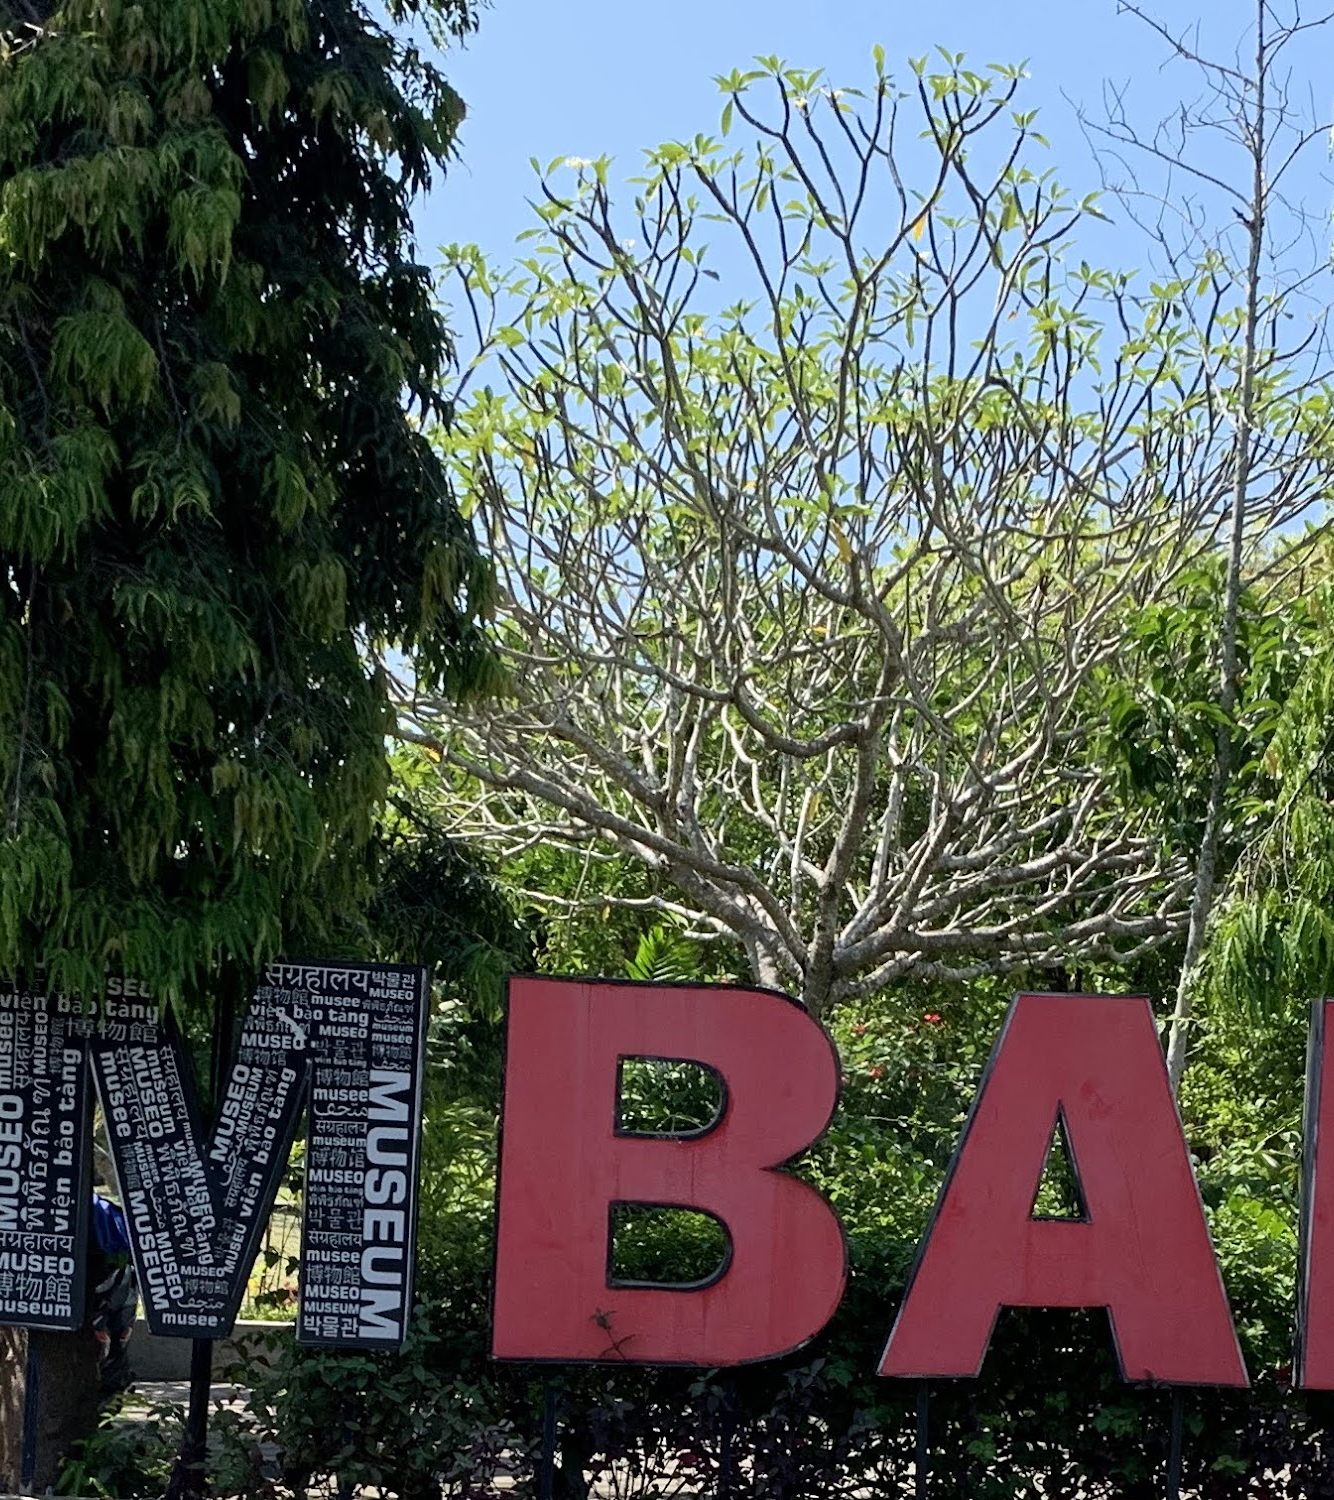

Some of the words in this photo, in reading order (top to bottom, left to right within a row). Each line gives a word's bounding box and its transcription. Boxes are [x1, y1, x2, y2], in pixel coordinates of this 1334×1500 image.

[369, 988, 414, 1000] MUSEO
[319, 1024, 368, 1039] MUSEO
[372, 1022, 414, 1033] museum
[33, 1011, 49, 1075] MUSEO
[241, 1032, 306, 1051] MUSEO
[99, 1051, 132, 1138] musee
[129, 1046, 165, 1139] MUSEO
[145, 1049, 177, 1134] museum
[235, 1067, 264, 1135] MUSEUM
[313, 1088, 369, 1102] musee
[209, 1064, 252, 1163] MUSEO
[312, 1136, 367, 1147] museum
[132, 1140, 155, 1190] MUSEO
[309, 1168, 365, 1184] MUSEO
[358, 1069, 412, 1340] MUSEUM
[128, 1190, 171, 1311] MUSEUM
[306, 1249, 361, 1263] musee
[155, 1231, 185, 1300] MUSEO
[180, 1265, 225, 1278] MUSEO
[305, 1284, 360, 1300] MUSEO
[304, 1301, 360, 1314] MUSEUM
